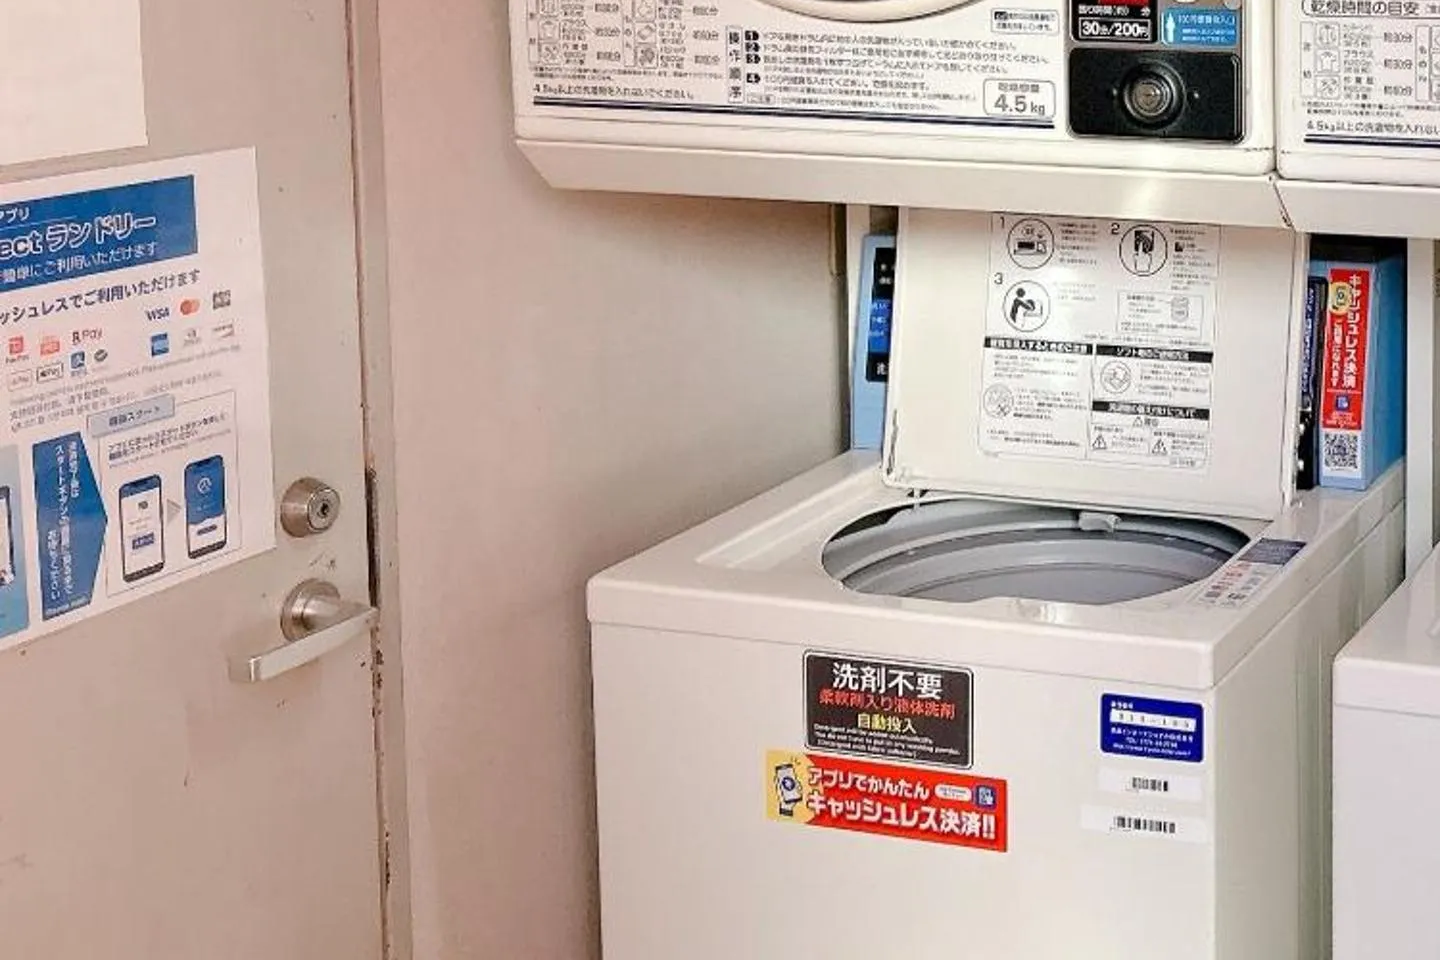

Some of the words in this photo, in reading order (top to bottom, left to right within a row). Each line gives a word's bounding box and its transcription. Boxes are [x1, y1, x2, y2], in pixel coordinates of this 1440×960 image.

[1311, 0, 1420, 16] 乾燥時間の目安
[1081, 20, 1149, 37] 30分/200円
[994, 92, 1027, 113] 4.5
[46, 212, 157, 252] ランドリー
[1111, 222, 1121, 235] 2
[994, 272, 1004, 285] 3
[1342, 272, 1363, 390] キャッシュレス決済
[832, 662, 944, 700] 洗剤不要
[819, 689, 956, 720] 柔軟剤入り液体洗剤
[857, 712, 917, 734] 自動投入
[808, 768, 930, 801] アプリでかんたん
[807, 792, 995, 840] キャッシュレス決済!!
